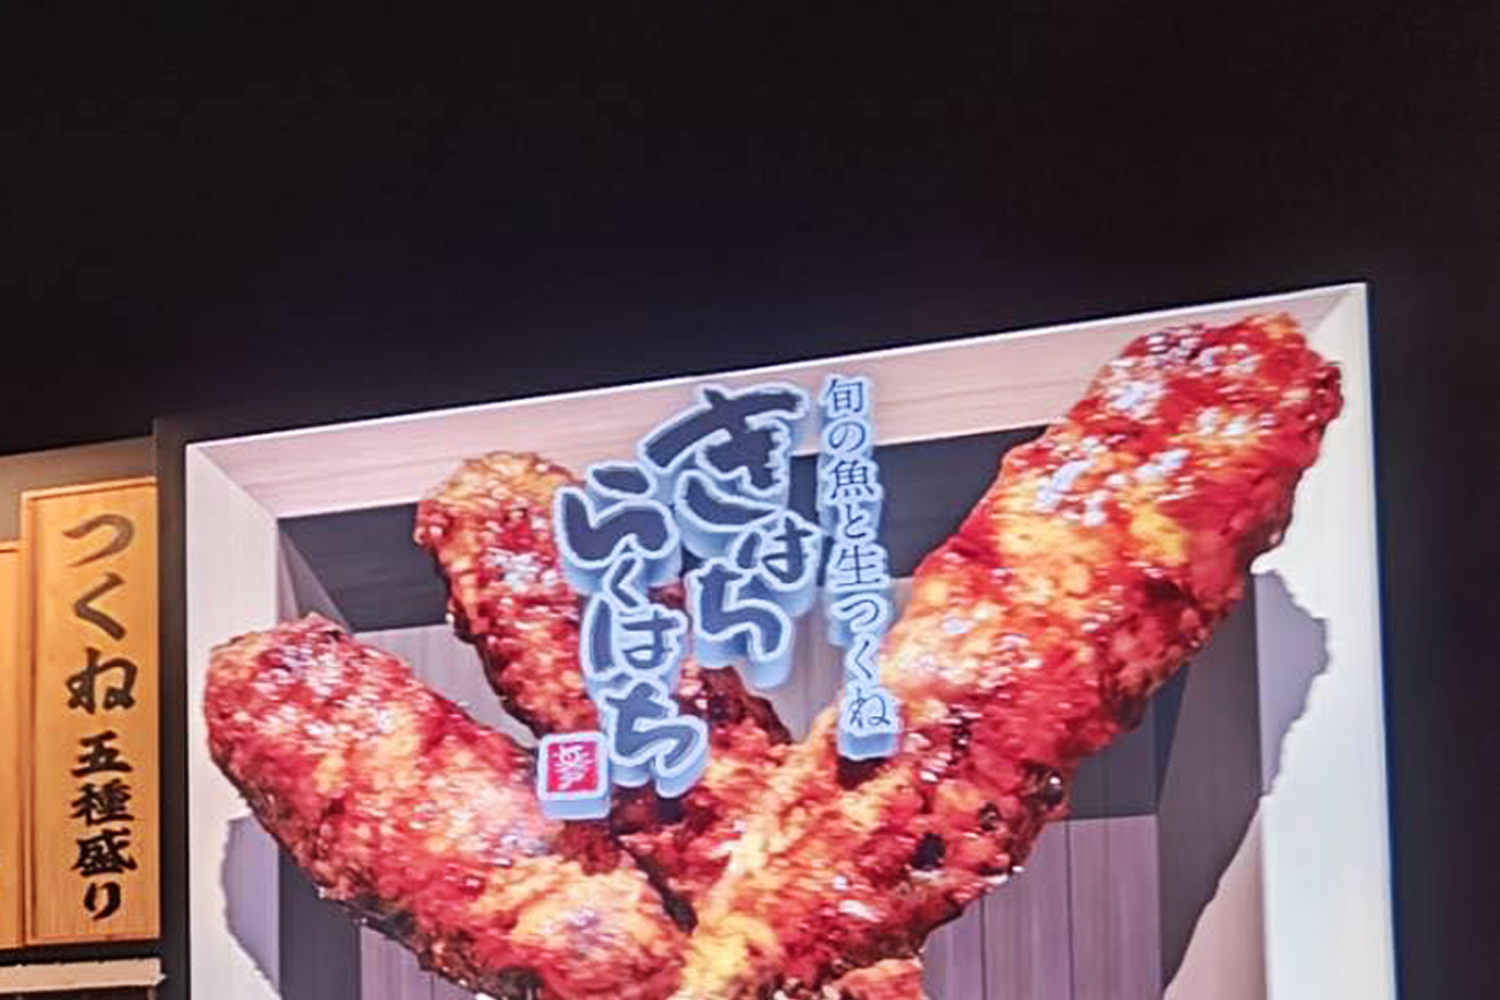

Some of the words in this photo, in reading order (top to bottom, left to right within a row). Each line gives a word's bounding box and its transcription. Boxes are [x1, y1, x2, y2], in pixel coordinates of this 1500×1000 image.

[62, 512, 139, 922] つくね五種盛り
[560, 465, 698, 774] らくはち
[828, 378, 892, 728] 旬の魚と生つくね
